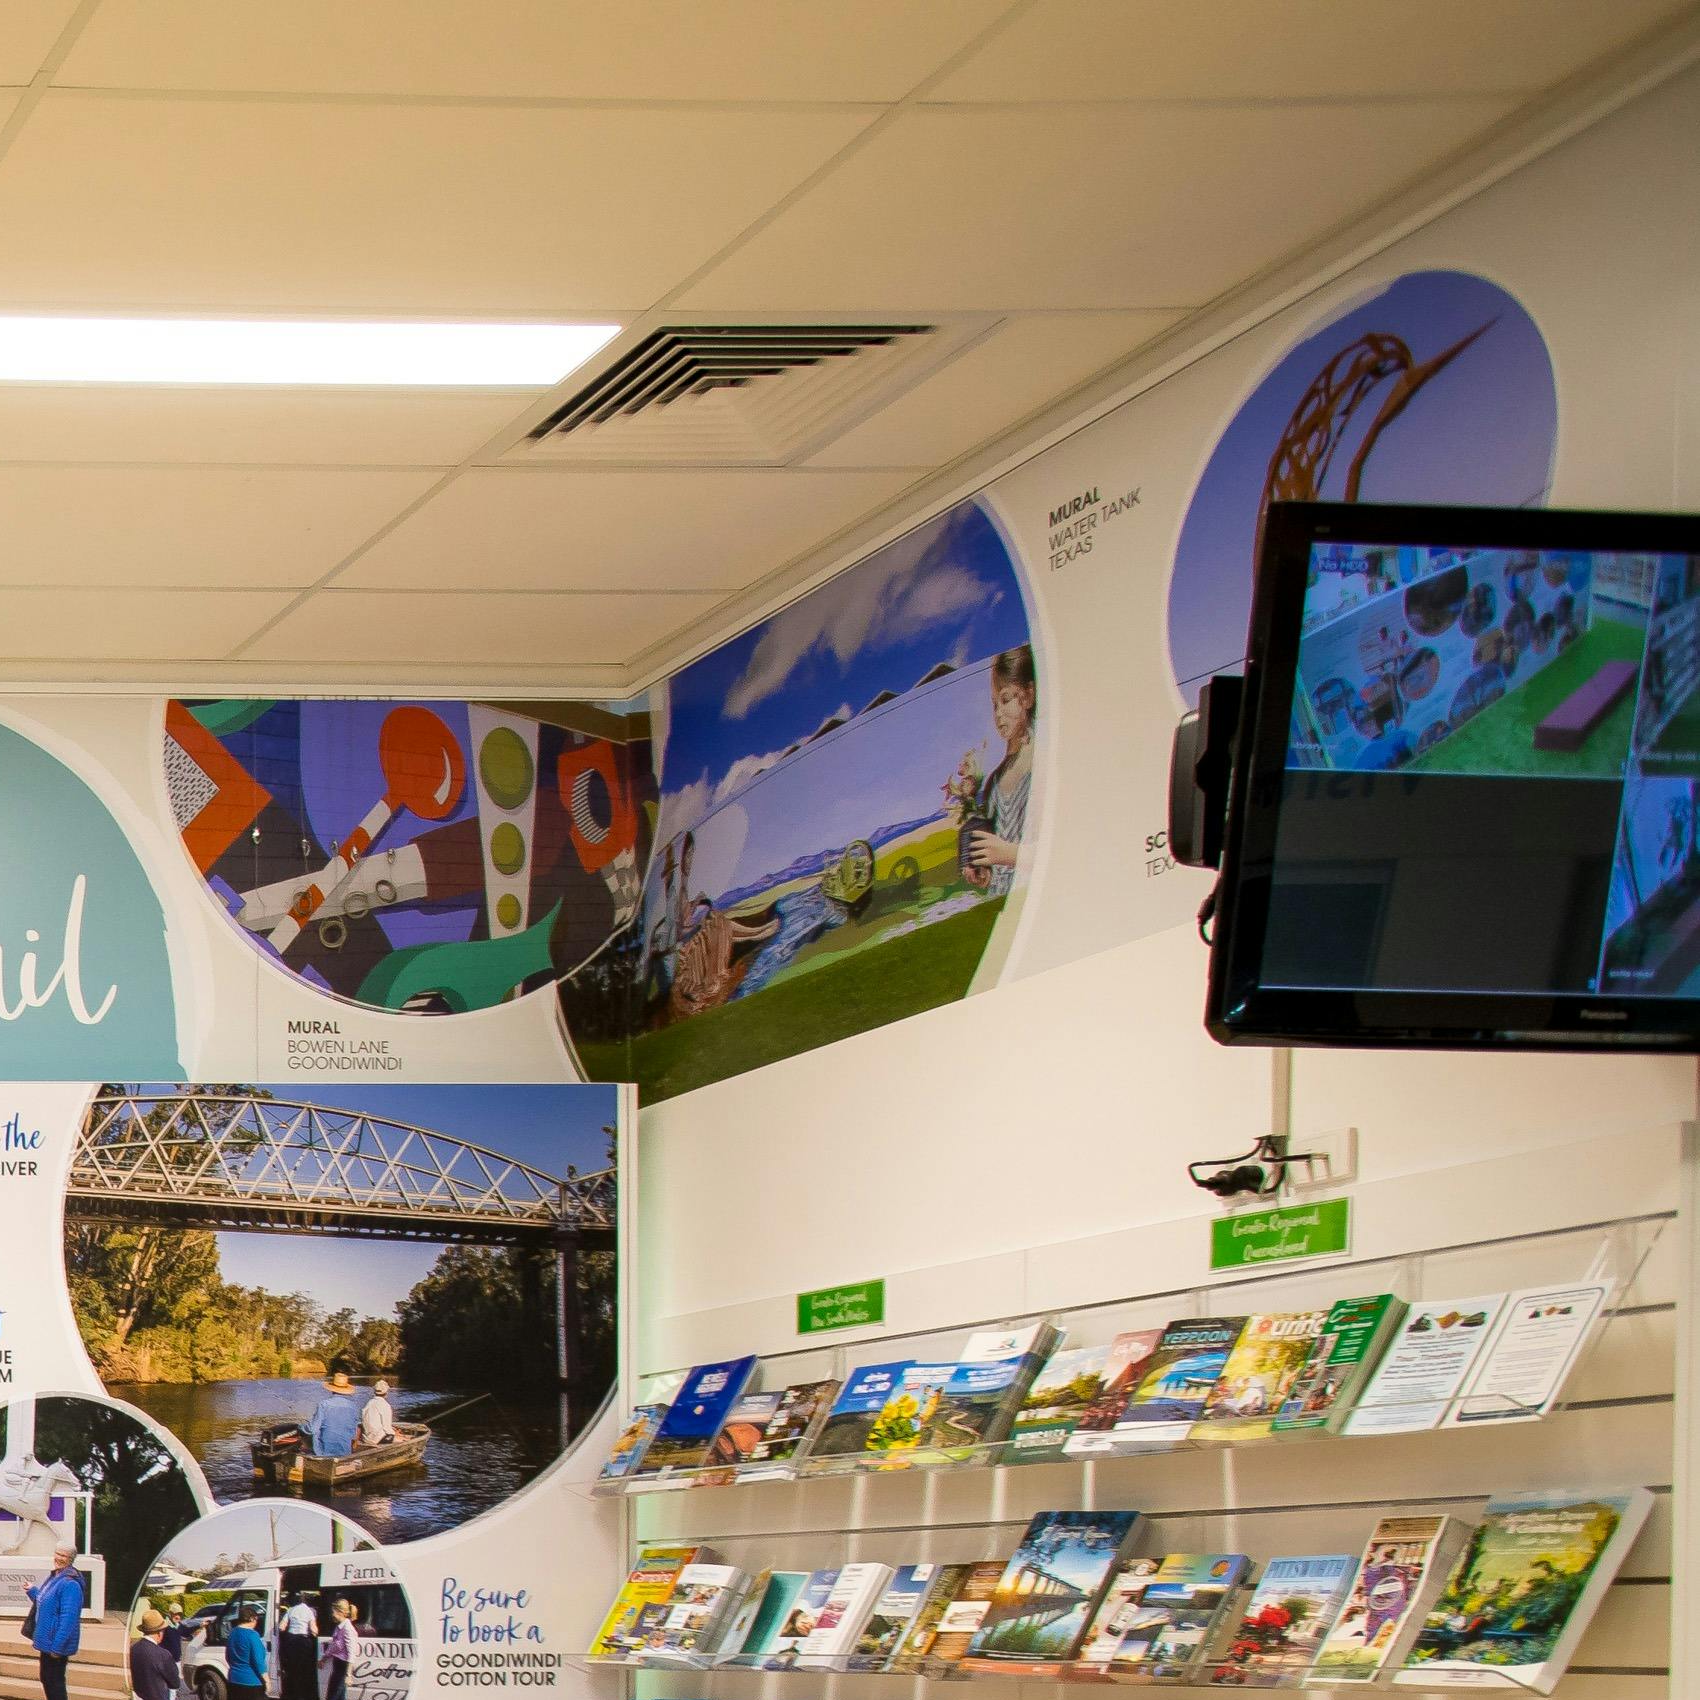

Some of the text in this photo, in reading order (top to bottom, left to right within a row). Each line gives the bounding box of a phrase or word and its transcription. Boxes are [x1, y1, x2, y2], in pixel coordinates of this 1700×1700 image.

[1048, 487, 1141, 551] WATER TANK
[1049, 487, 1100, 528] MURAL
[1048, 535, 1093, 572] TEXAS
[288, 1021, 340, 1034] MURAL
[288, 1040, 388, 1054] BOWEN LANE
[288, 1056, 401, 1070] GOONDIWINDI
[6, 1113, 40, 1151] the
[343, 1564, 385, 1580] Farm
[442, 1578, 526, 1612] Be sure
[440, 1611, 544, 1645] to book a
[437, 1654, 562, 1668] GOONDIWINDI
[437, 1672, 555, 1686] COTTON TOUR
